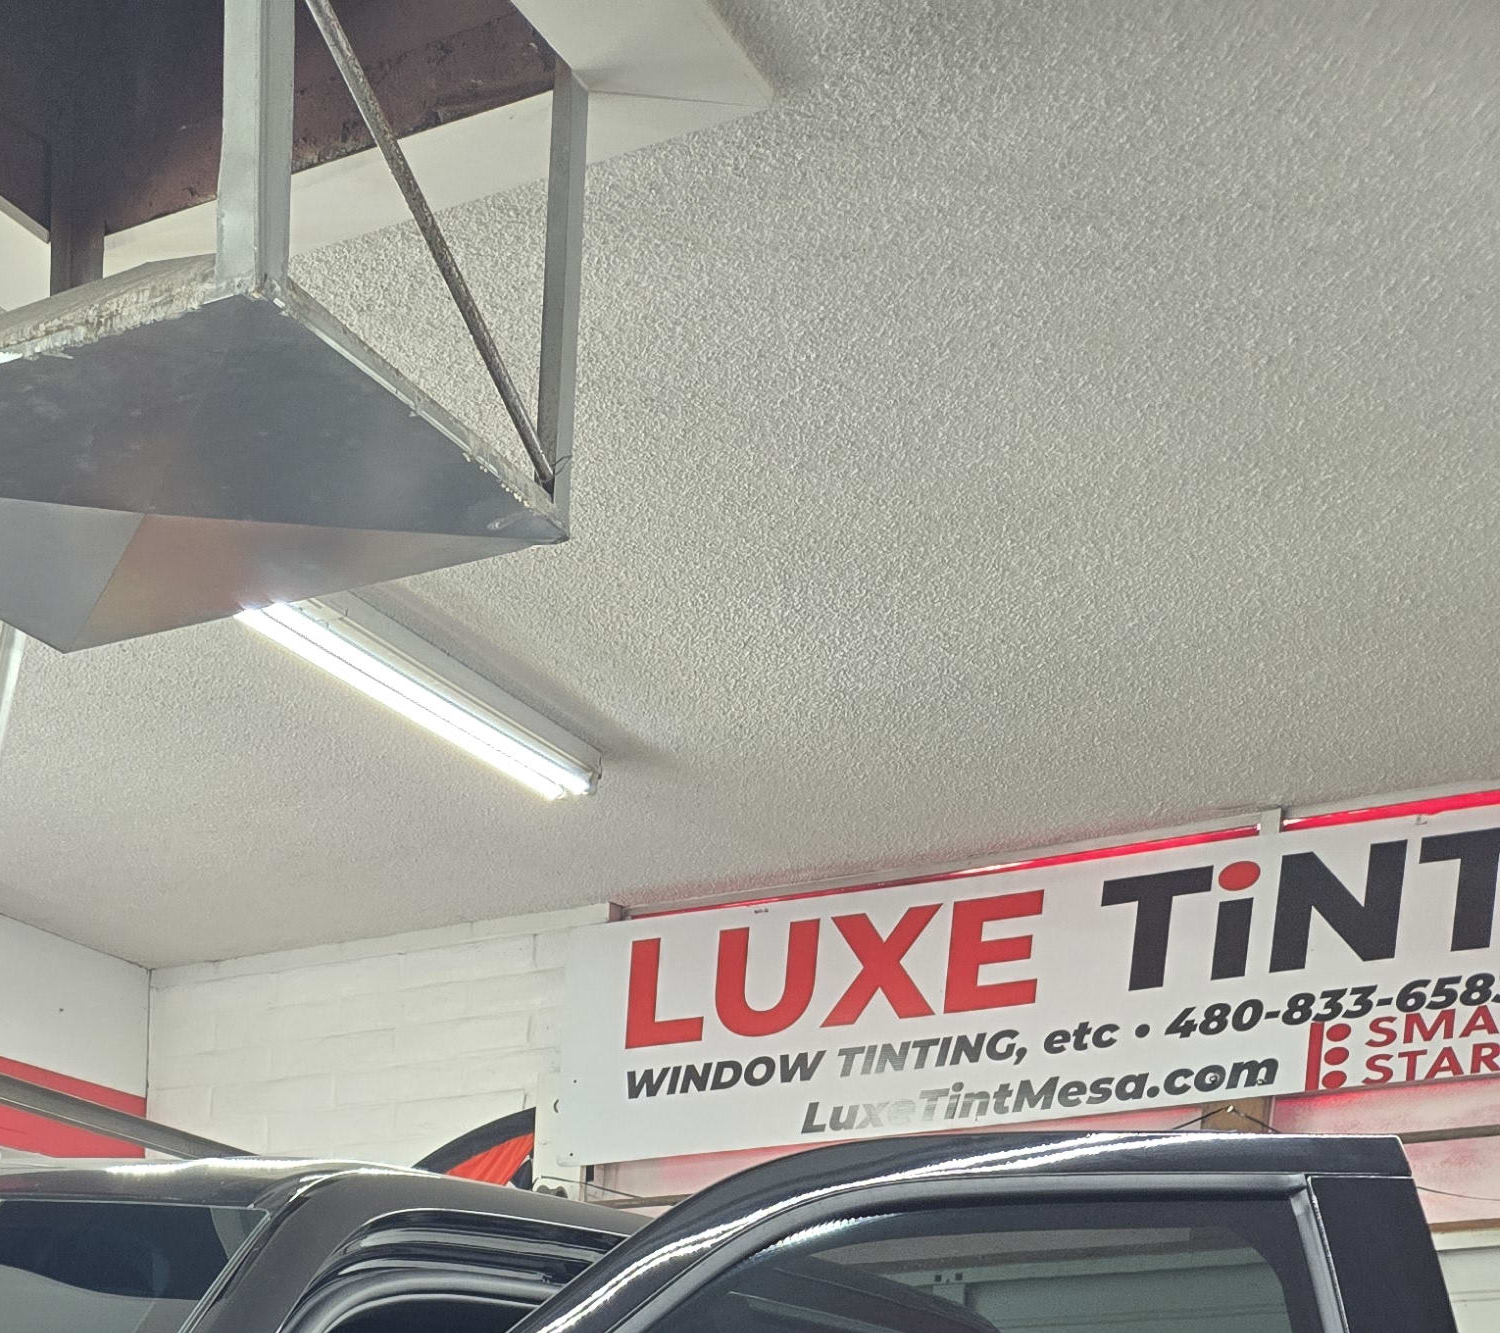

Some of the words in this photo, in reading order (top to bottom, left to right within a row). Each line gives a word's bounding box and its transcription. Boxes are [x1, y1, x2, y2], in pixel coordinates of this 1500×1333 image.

[625, 889, 1045, 1049] LUXE
[626, 1049, 826, 1100] WINDOW
[837, 1028, 1028, 1078] TINTING,
[1043, 1020, 1121, 1055] etc
[1164, 972, 1500, 1039] 480-833-658
[800, 1057, 1280, 1135] LuxeTintMesa.com
